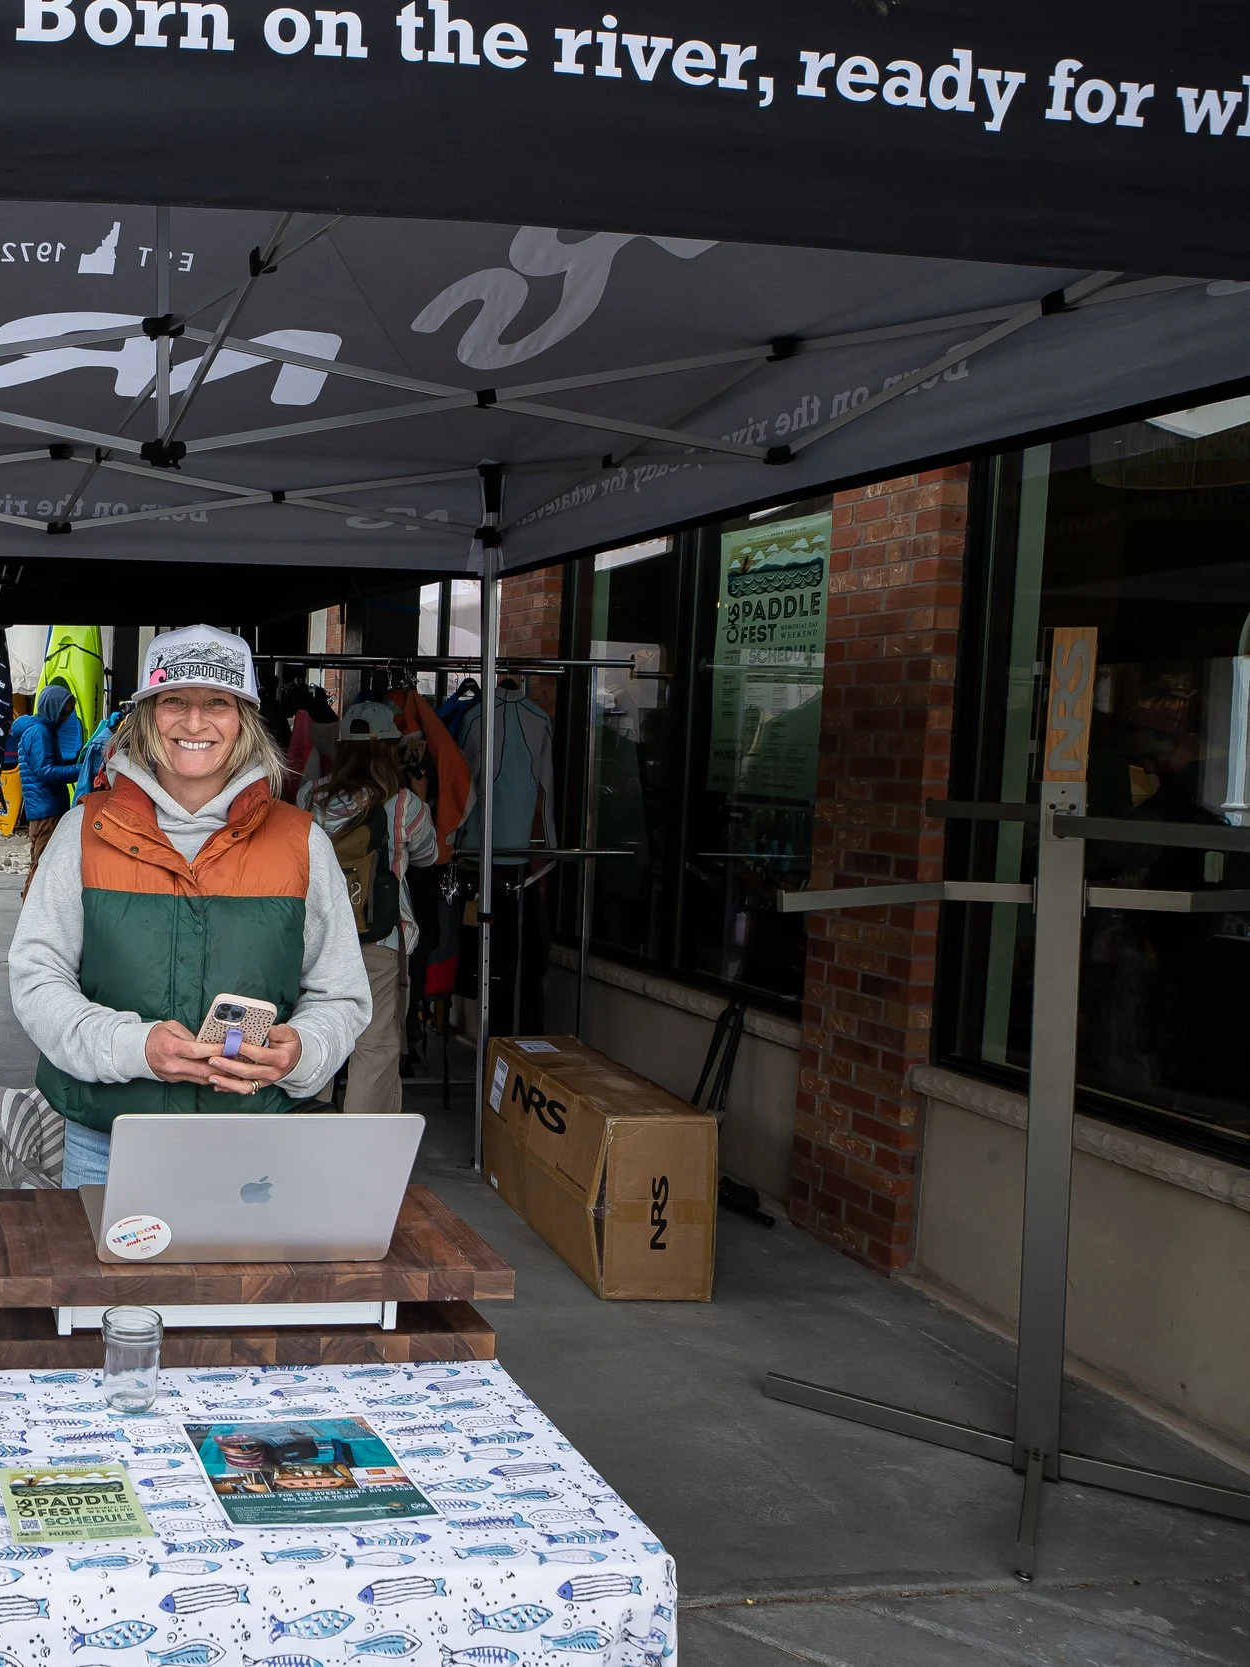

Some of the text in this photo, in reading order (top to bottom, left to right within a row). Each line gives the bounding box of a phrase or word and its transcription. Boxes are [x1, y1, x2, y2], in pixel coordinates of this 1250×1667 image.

[15, 0, 1250, 137] Born on the river, ready for w
[741, 591, 822, 622] PADDLE
[740, 623, 778, 644] FEST
[780, 629, 818, 640] WEEKEND
[188, 664, 245, 689] PADDLEFEST
[1047, 639, 1091, 772] NRS
[512, 1074, 568, 1135] NRS
[650, 1175, 669, 1250] NRS
[34, 1493, 129, 1508] PADDLE
[38, 1507, 82, 1518] FEST
[44, 1513, 137, 1526] SCHEDULE
